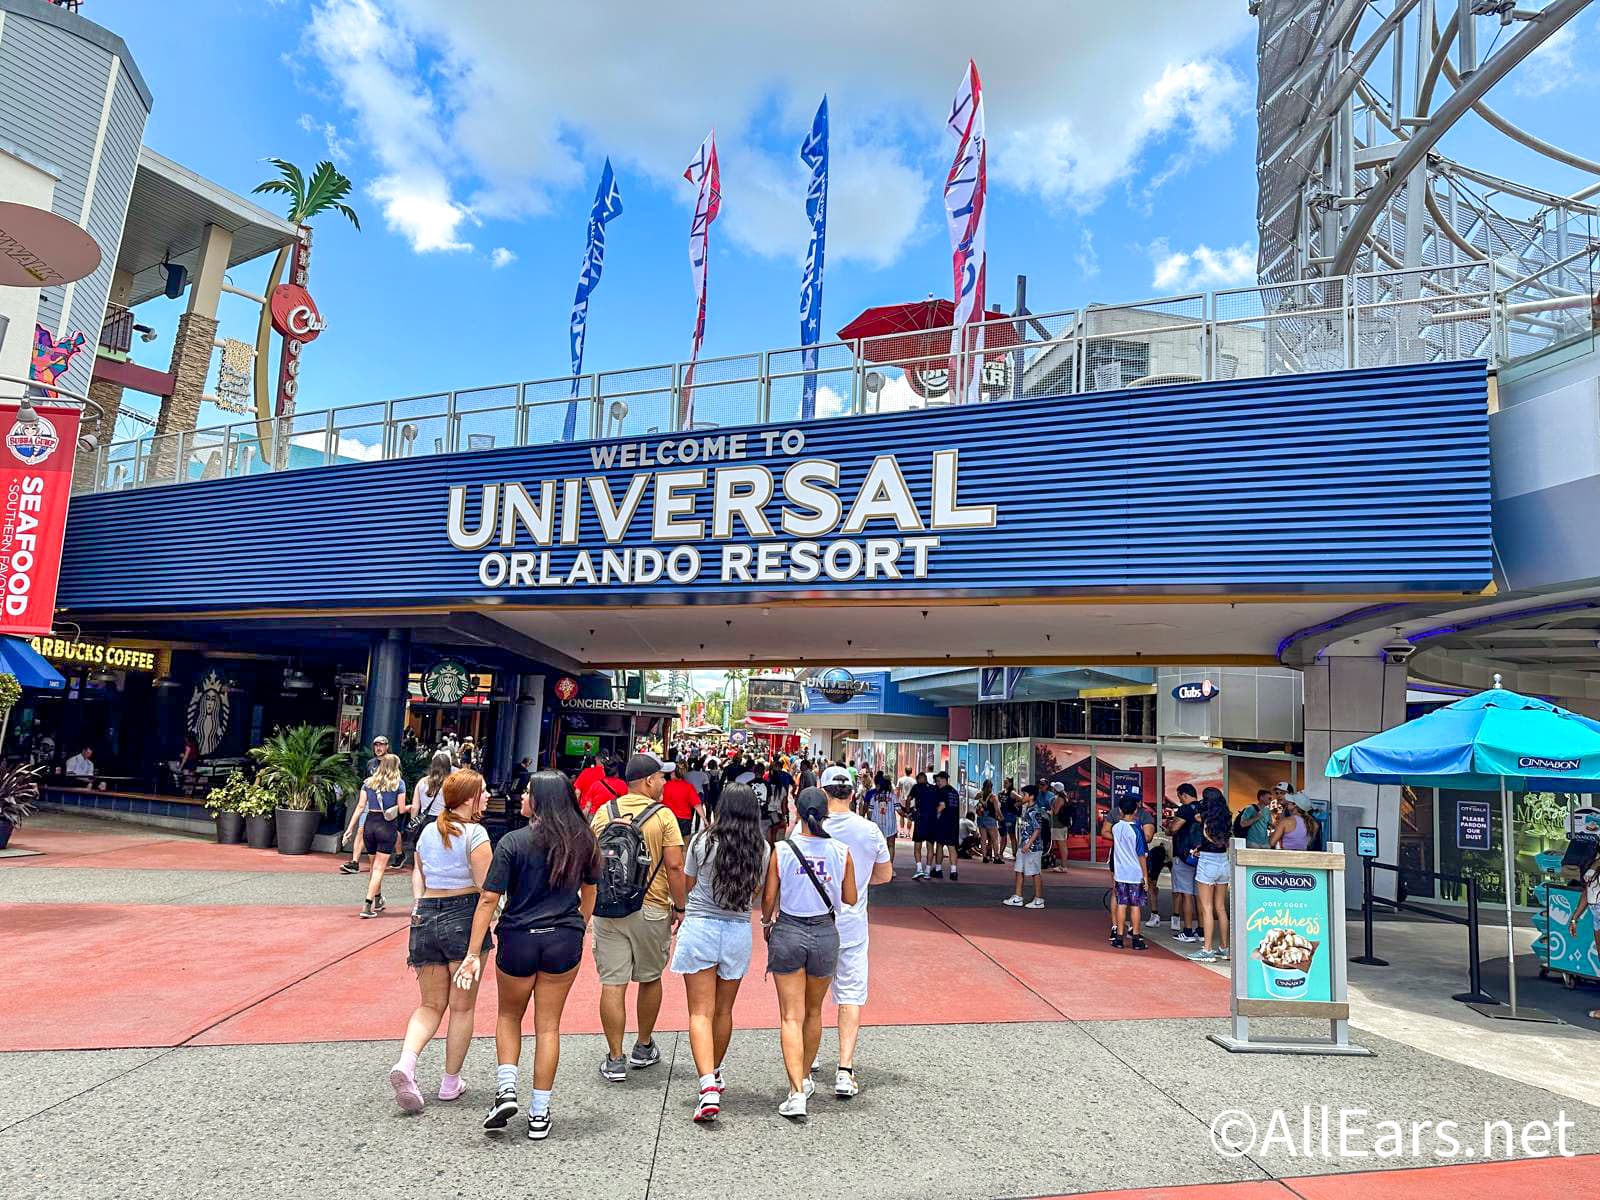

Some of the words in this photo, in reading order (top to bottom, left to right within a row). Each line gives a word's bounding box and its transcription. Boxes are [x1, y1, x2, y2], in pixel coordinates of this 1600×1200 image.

[288, 305, 328, 335] Club
[591, 434, 748, 469] WELCOME
[760, 429, 805, 456] TO
[447, 448, 998, 551] UNIVERSAL
[5, 476, 44, 616] SEAFOOD
[478, 544, 702, 588] ORLANDO
[720, 536, 941, 583] RESORT
[31, 636, 104, 663] ARBUCKS
[105, 647, 155, 670] COFFEE
[561, 698, 625, 710] CONCIERGE
[1179, 686, 1202, 699] Clubs
[1519, 757, 1579, 769] CINNABON
[1255, 875, 1312, 888] CINNABON
[1246, 907, 1321, 935] Goodness
